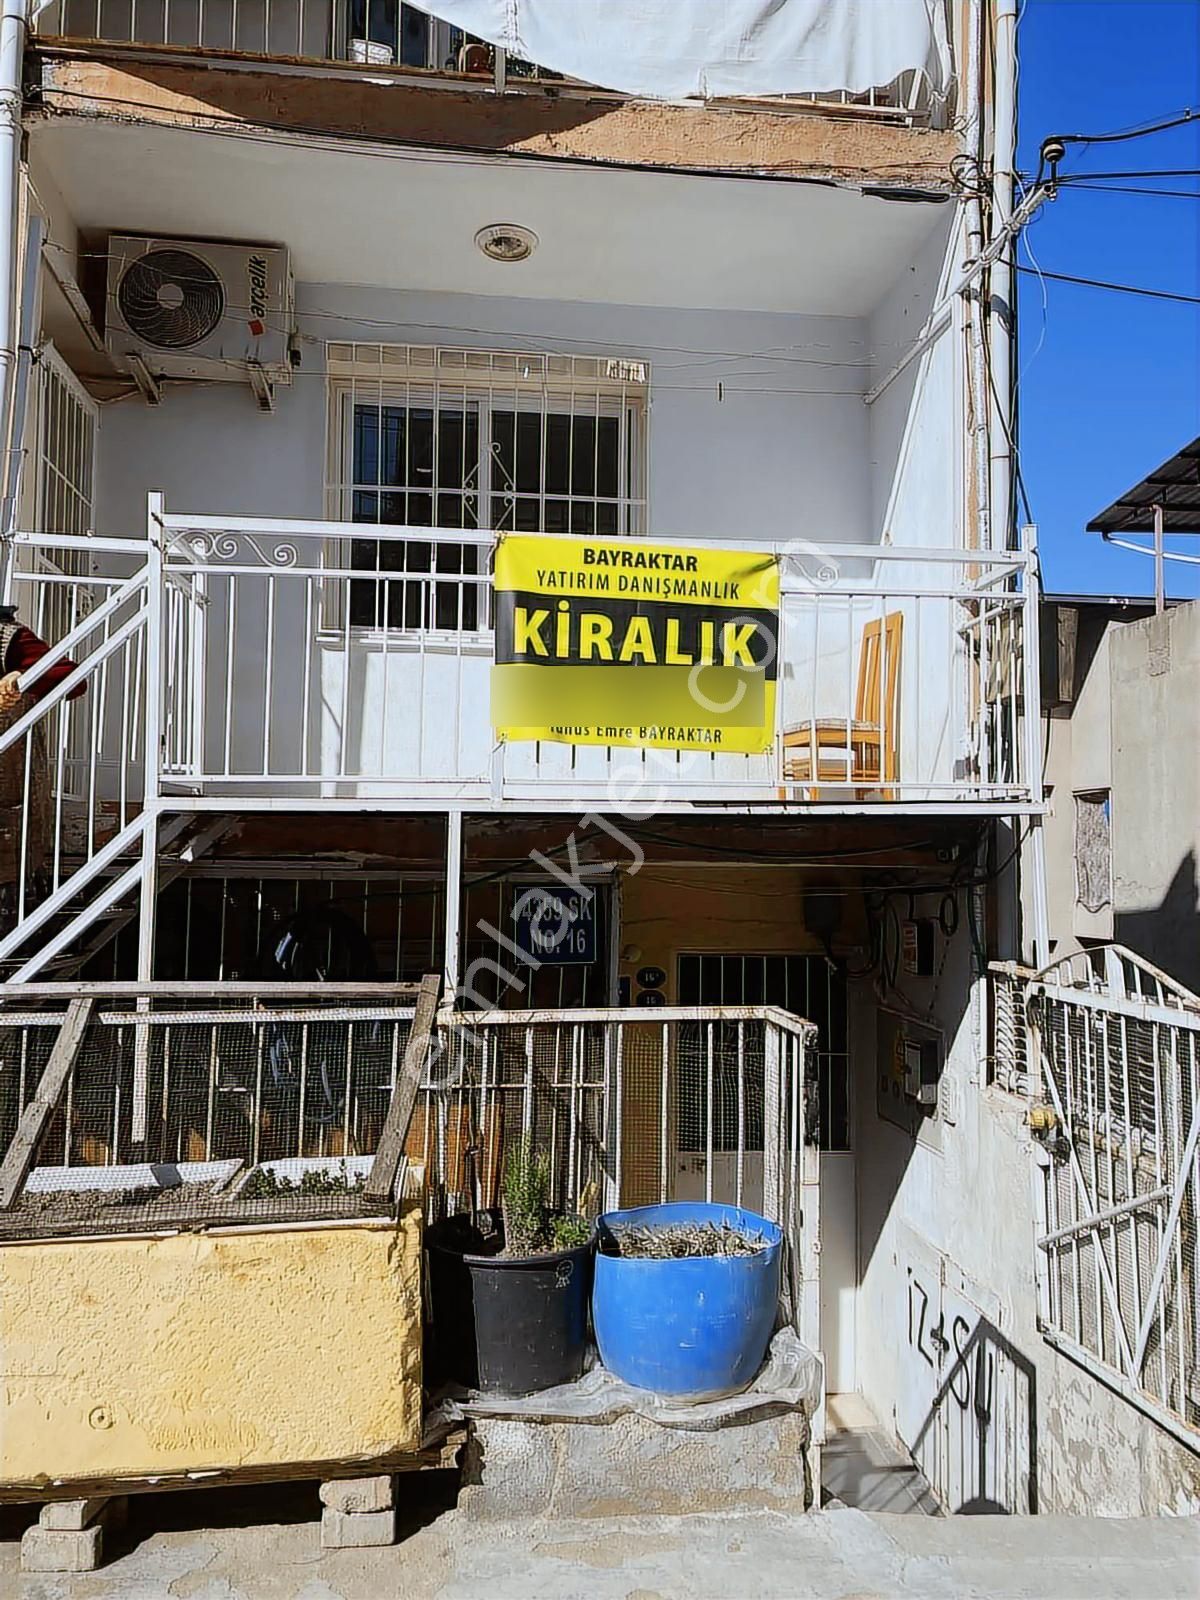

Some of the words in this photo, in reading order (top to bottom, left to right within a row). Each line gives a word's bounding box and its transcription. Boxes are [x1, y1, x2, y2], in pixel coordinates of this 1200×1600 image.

[249, 255, 269, 318] arçelik
[583, 548, 698, 572] BAYRAKTAR
[537, 570, 610, 591] YATIRIM
[618, 574, 740, 599] DANIŞMANLIK
[513, 600, 758, 666] KİRALIK
[639, 727, 722, 743] BAYRAKTAR
[569, 896, 592, 921] SK
[566, 928, 586, 954] 16
